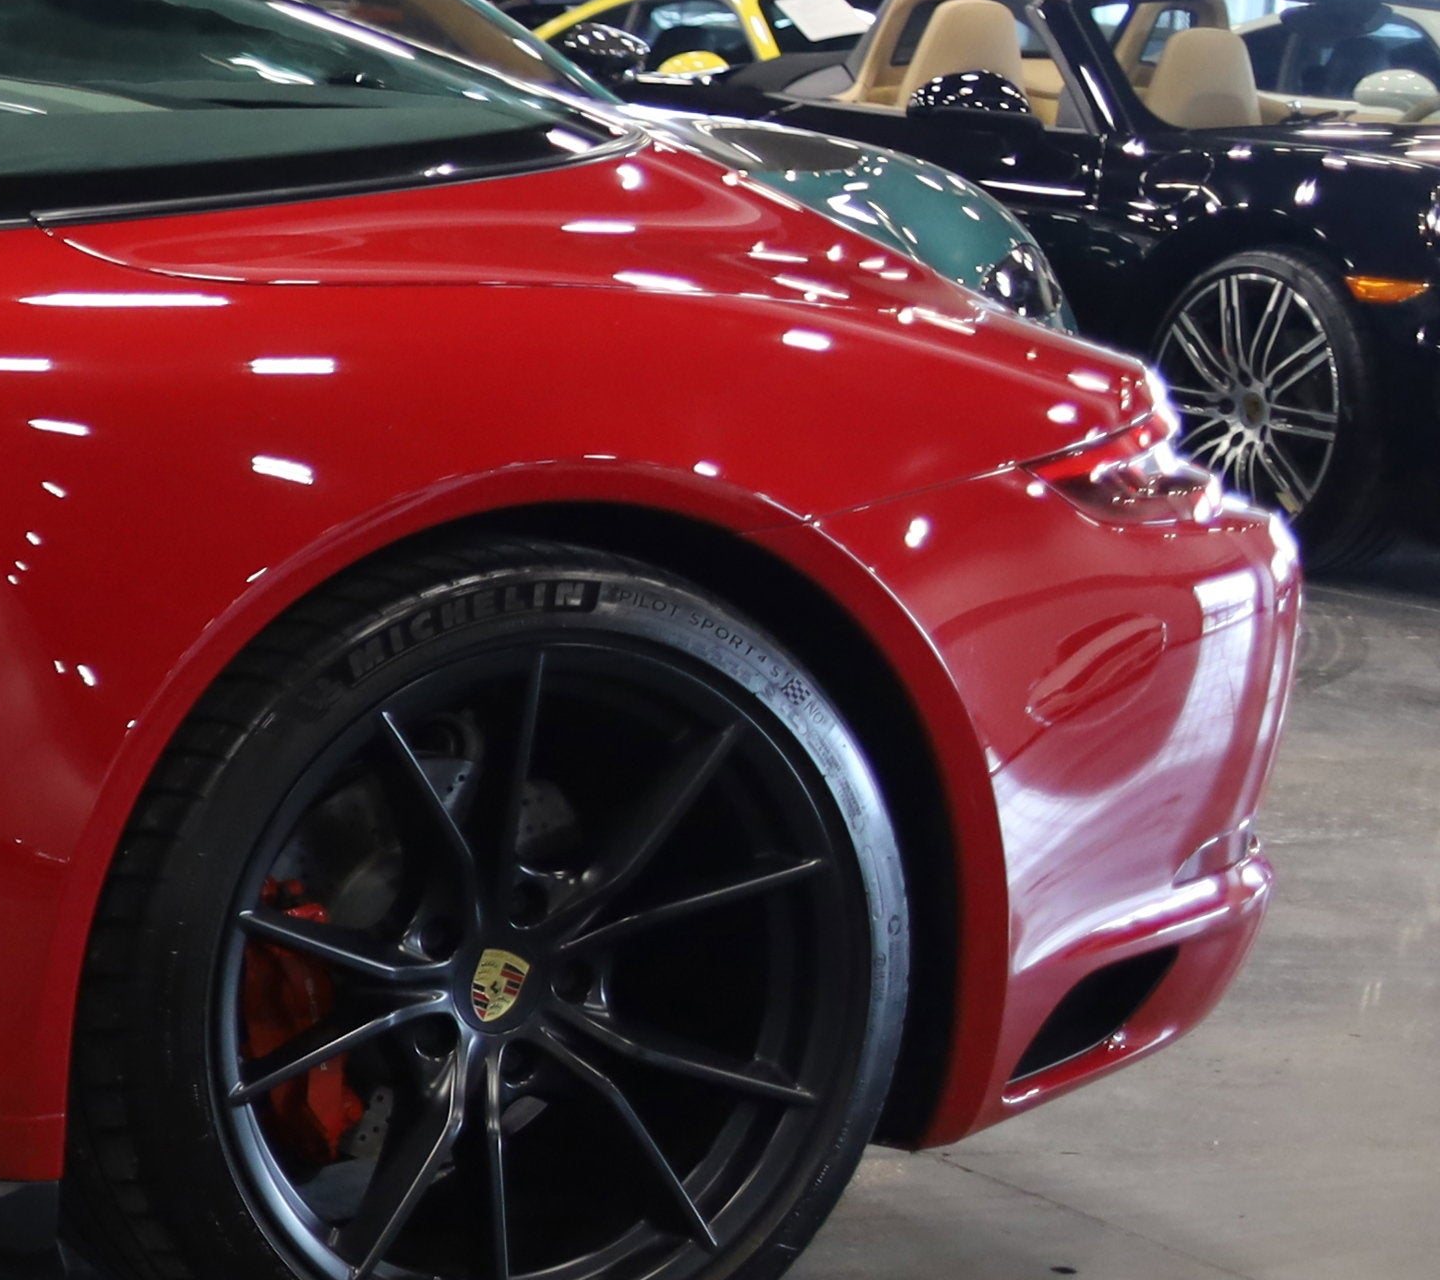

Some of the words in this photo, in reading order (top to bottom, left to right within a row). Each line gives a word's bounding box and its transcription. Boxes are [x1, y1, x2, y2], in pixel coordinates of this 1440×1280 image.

[348, 582, 585, 679] MICHELIN
[618, 590, 680, 617] PILOT
[689, 612, 755, 656] SPORT
